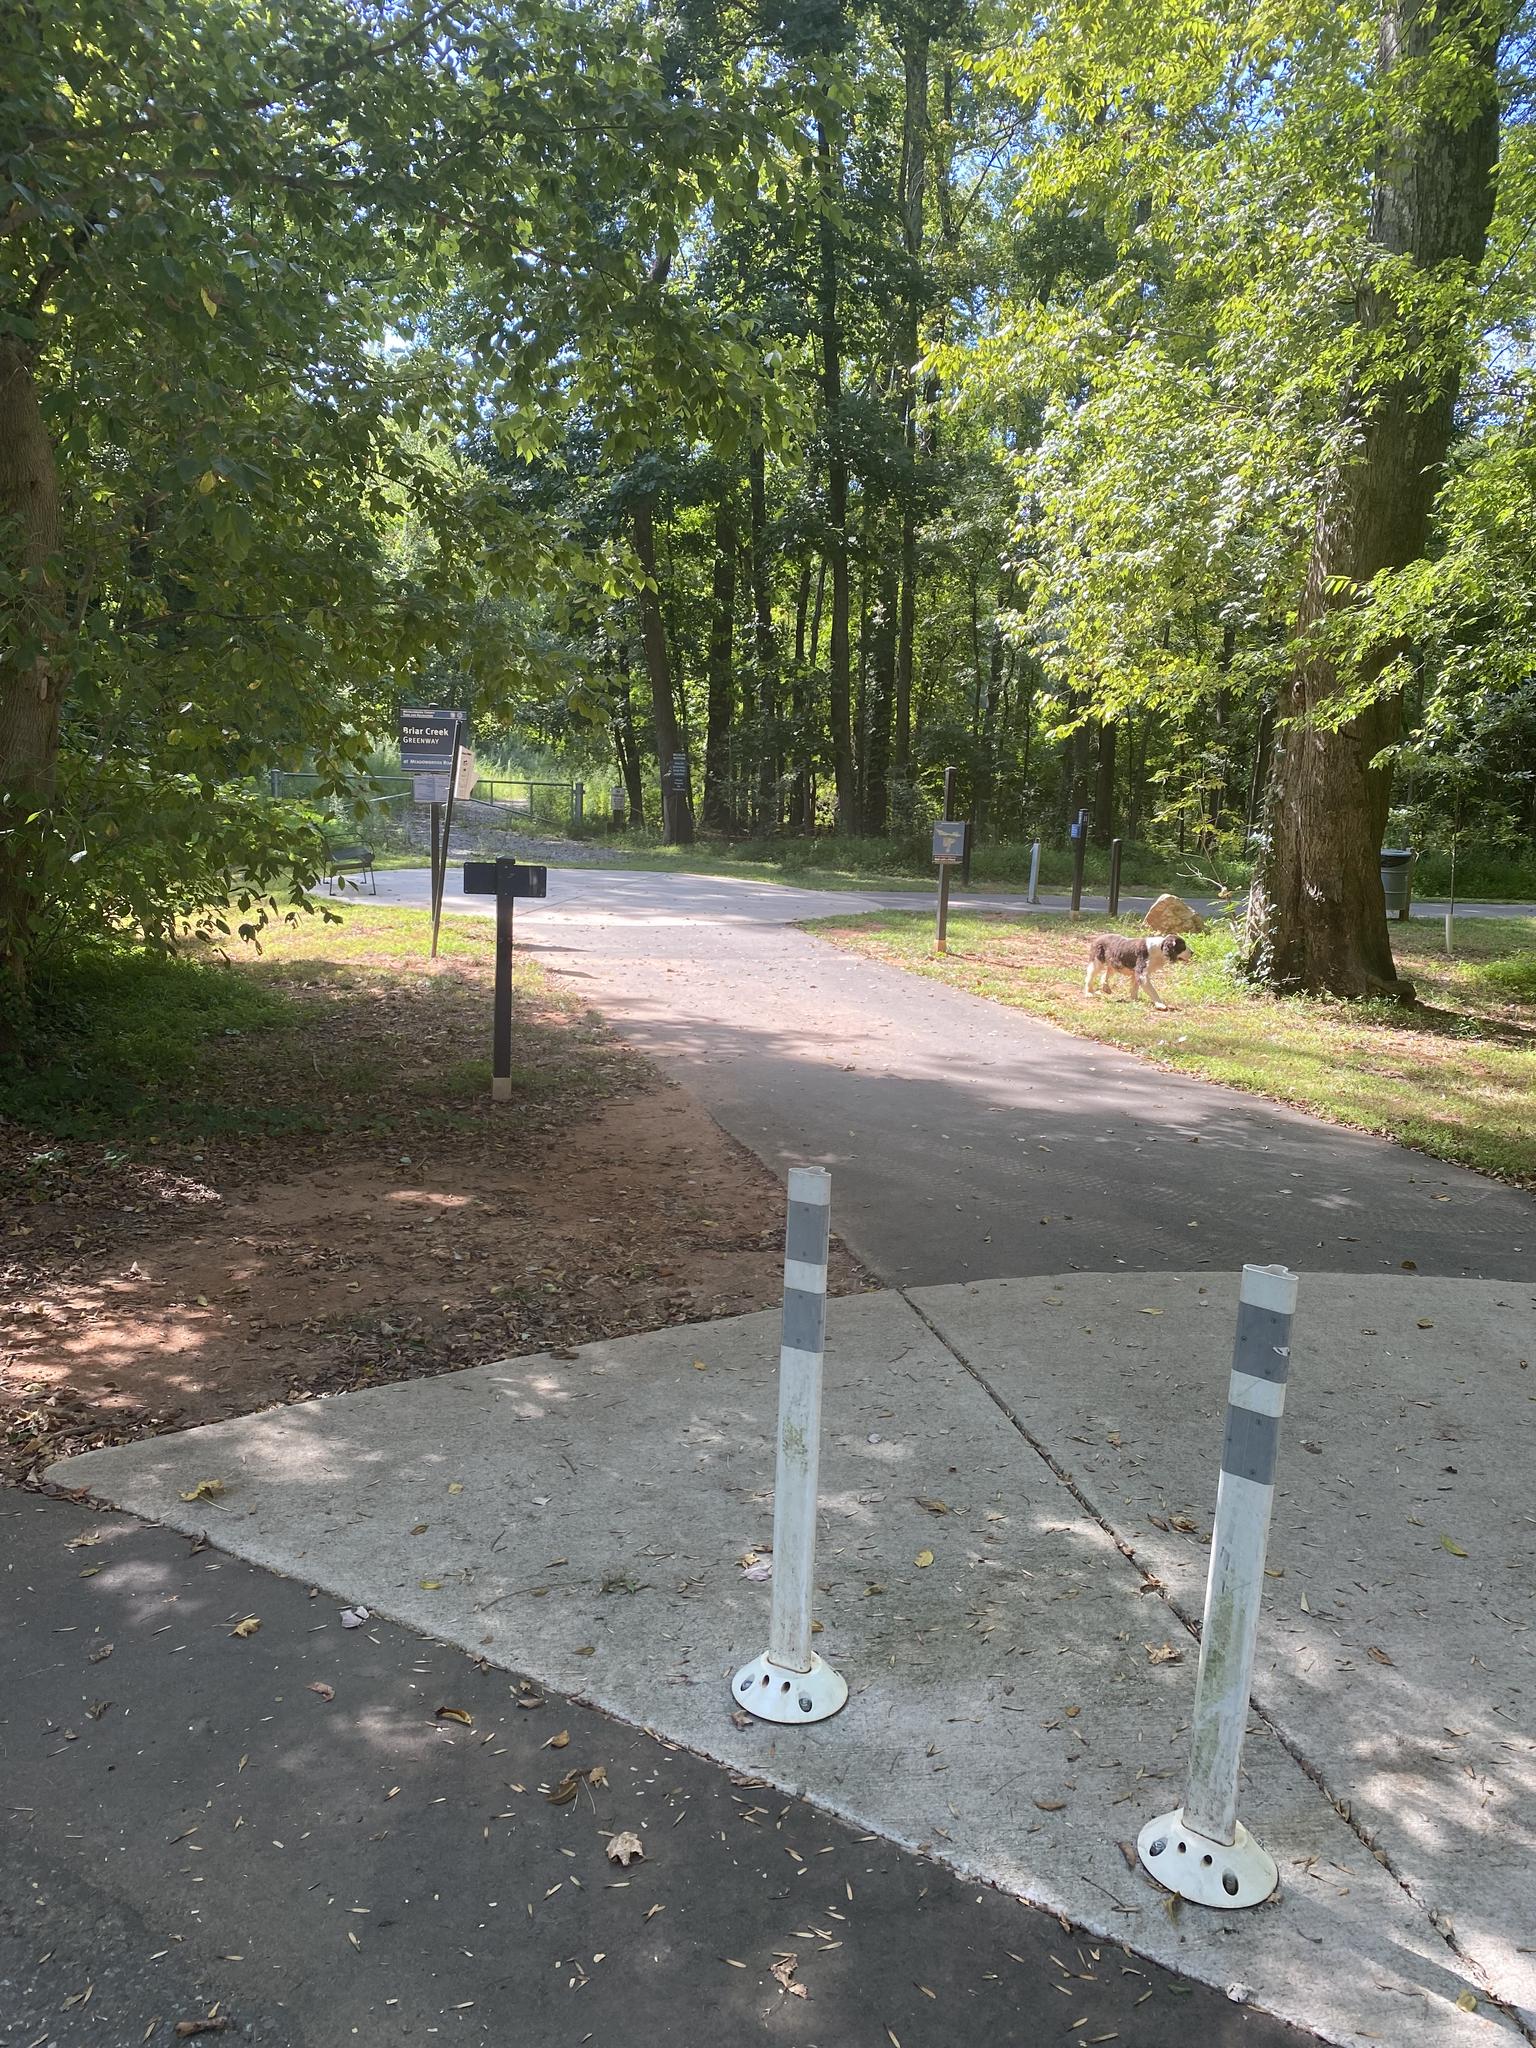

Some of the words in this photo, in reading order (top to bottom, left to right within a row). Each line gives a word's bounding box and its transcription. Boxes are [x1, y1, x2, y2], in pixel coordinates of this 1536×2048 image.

[403, 726, 424, 735] Briar
[425, 727, 449, 736] Creek
[403, 736, 440, 744] GREENWAY
